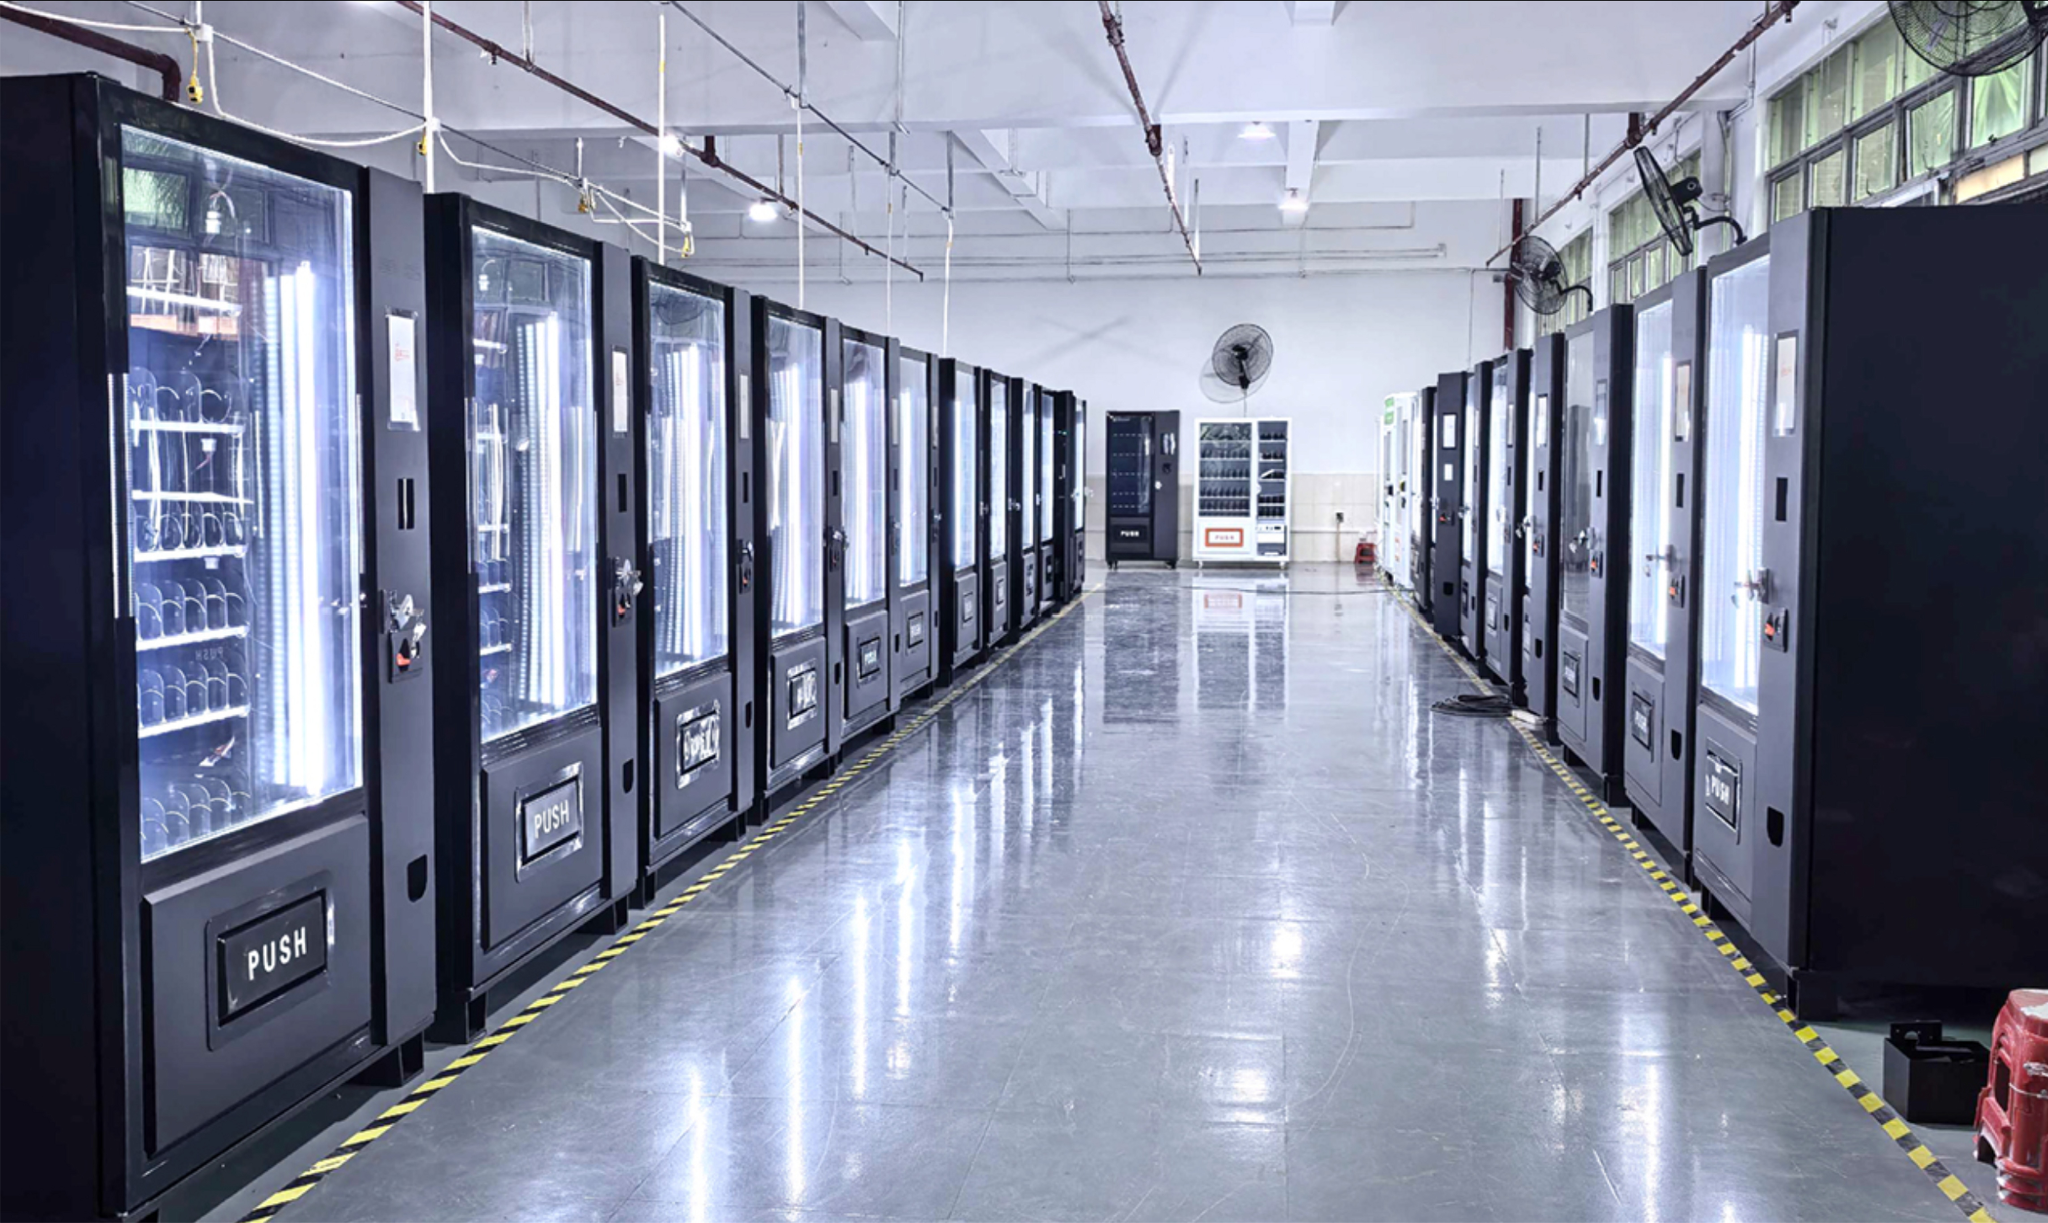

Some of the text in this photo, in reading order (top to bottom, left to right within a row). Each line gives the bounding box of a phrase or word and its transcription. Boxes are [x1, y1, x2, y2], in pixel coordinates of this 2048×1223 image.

[1711, 774, 1730, 805] PUSH
[534, 799, 570, 839] PUSH
[247, 926, 307, 981] PUSH
